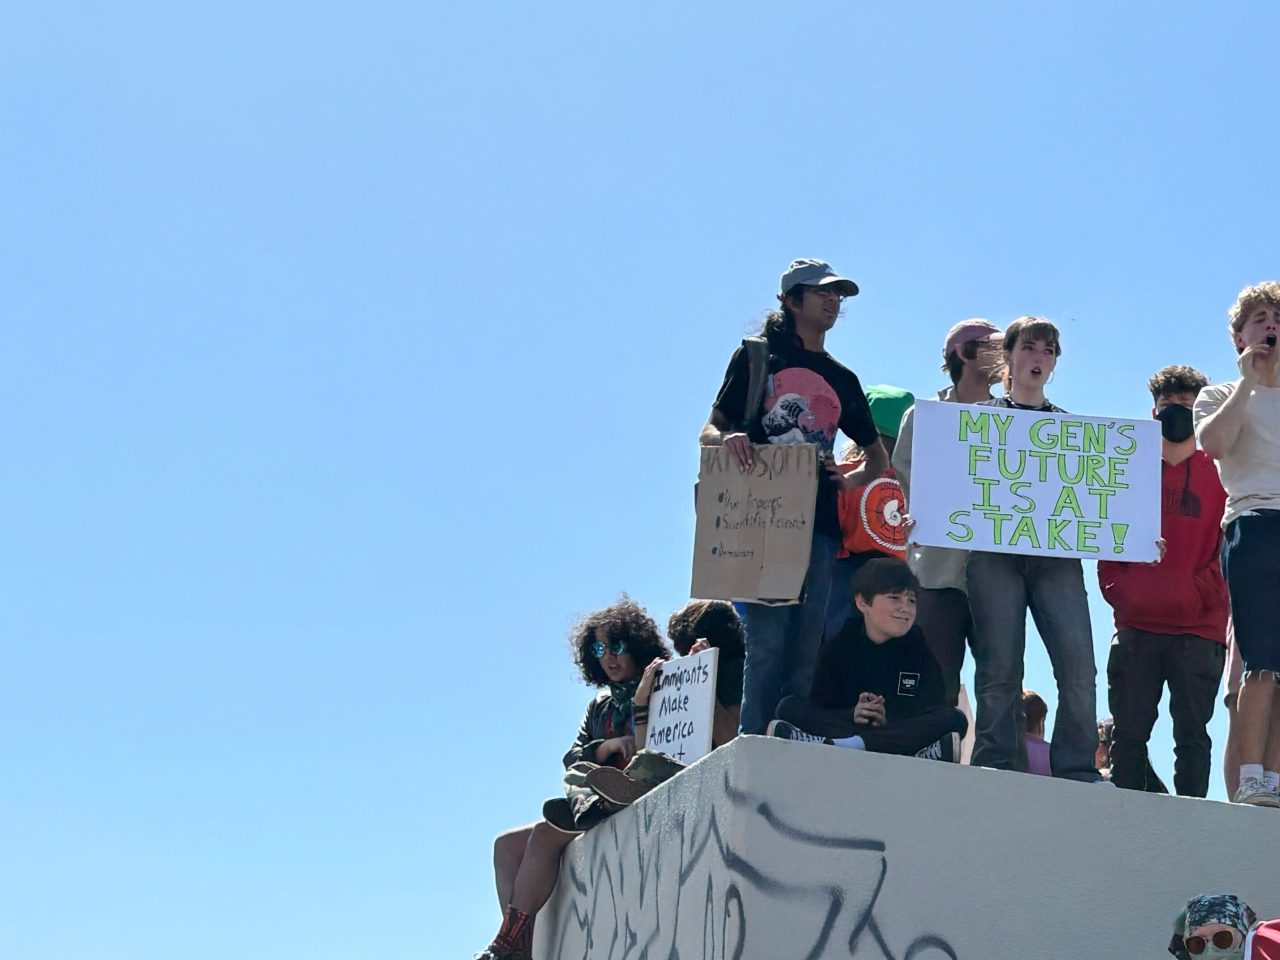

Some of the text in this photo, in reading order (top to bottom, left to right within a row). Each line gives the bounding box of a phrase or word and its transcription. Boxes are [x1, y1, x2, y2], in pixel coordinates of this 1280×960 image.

[958, 409, 1138, 455] MY GEN'S
[968, 444, 1130, 489] FUTURE
[972, 477, 1117, 519] IS AT
[946, 510, 1130, 554] STAKE!
[653, 656, 709, 692] Immigrants
[658, 692, 690, 718] Make
[647, 720, 695, 747] America
